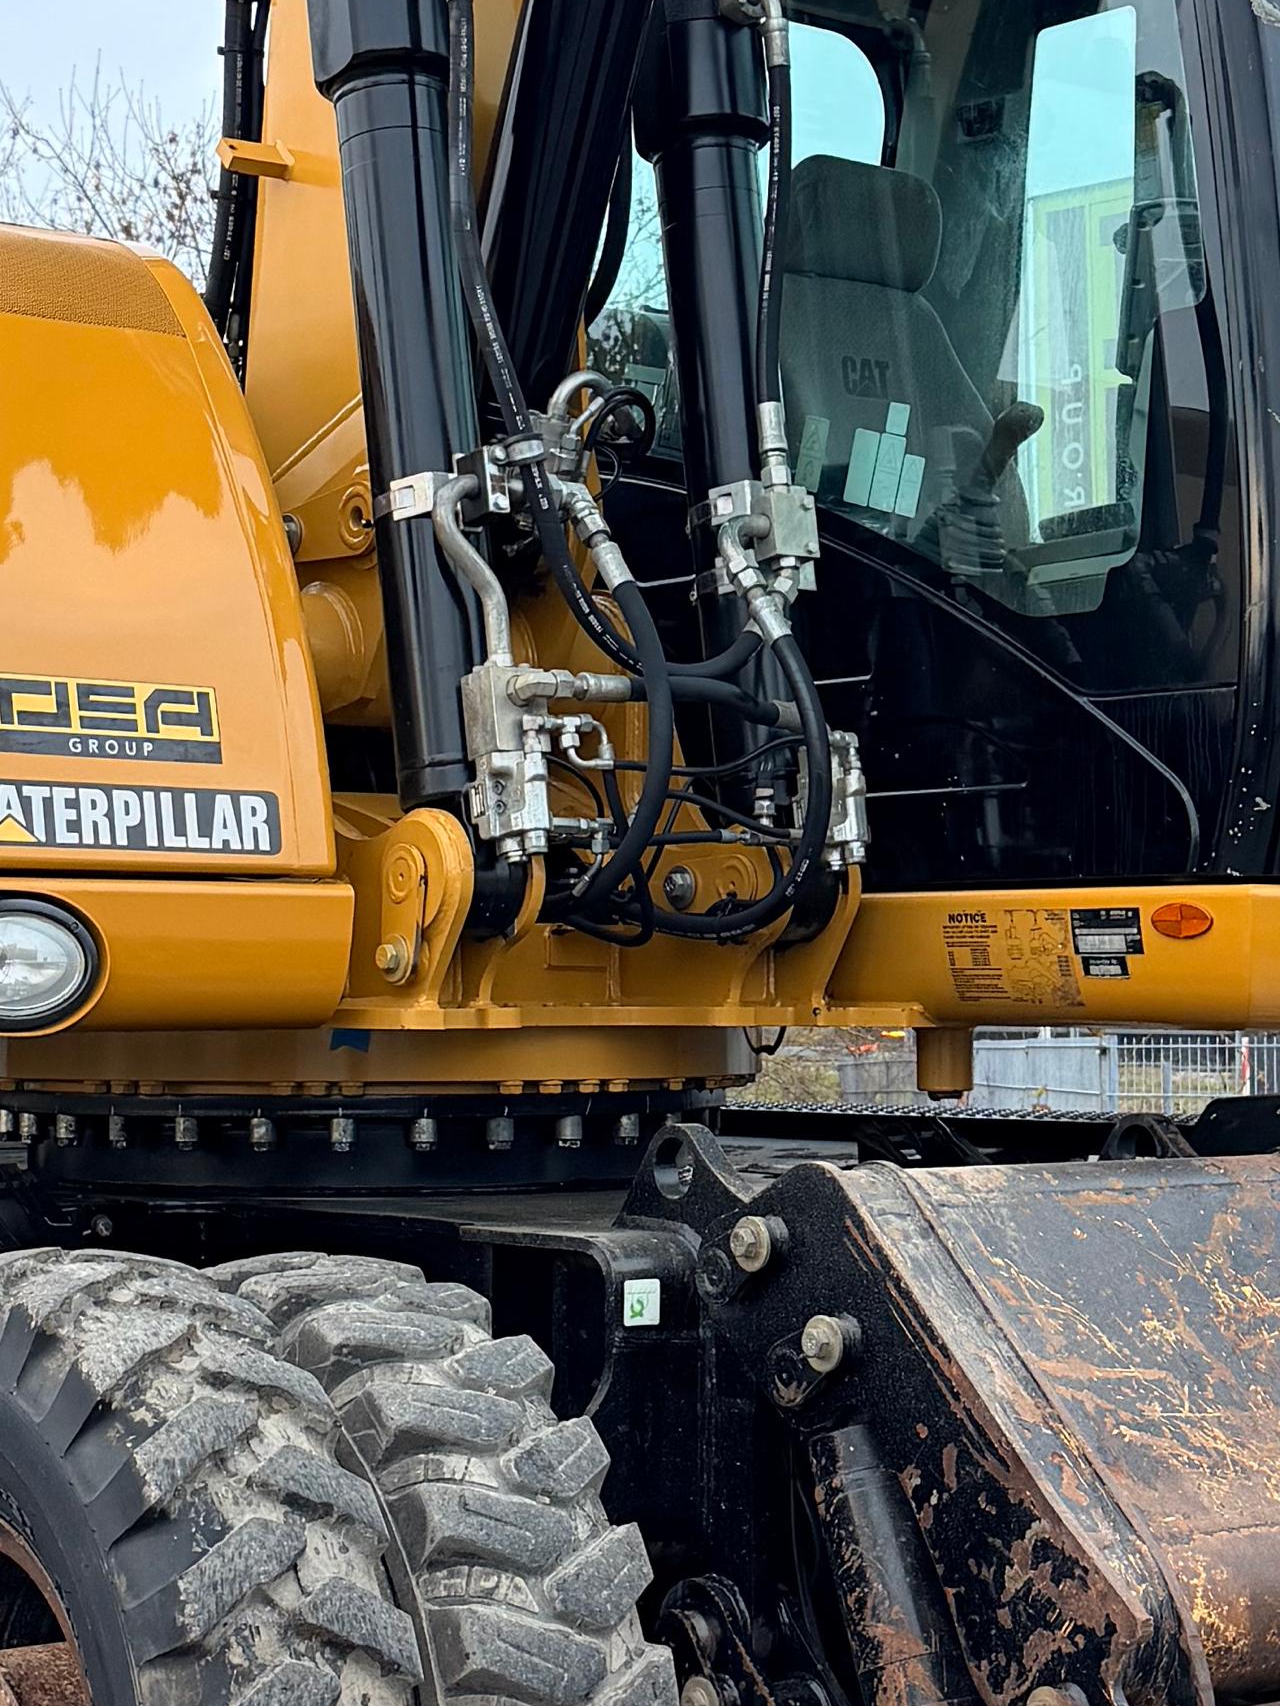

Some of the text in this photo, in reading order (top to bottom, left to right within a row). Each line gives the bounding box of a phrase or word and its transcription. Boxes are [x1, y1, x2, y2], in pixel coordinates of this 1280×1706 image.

[841, 355, 890, 400] CAT
[68, 738, 154, 757] GROUP
[948, 912, 987, 924] NOTICE
